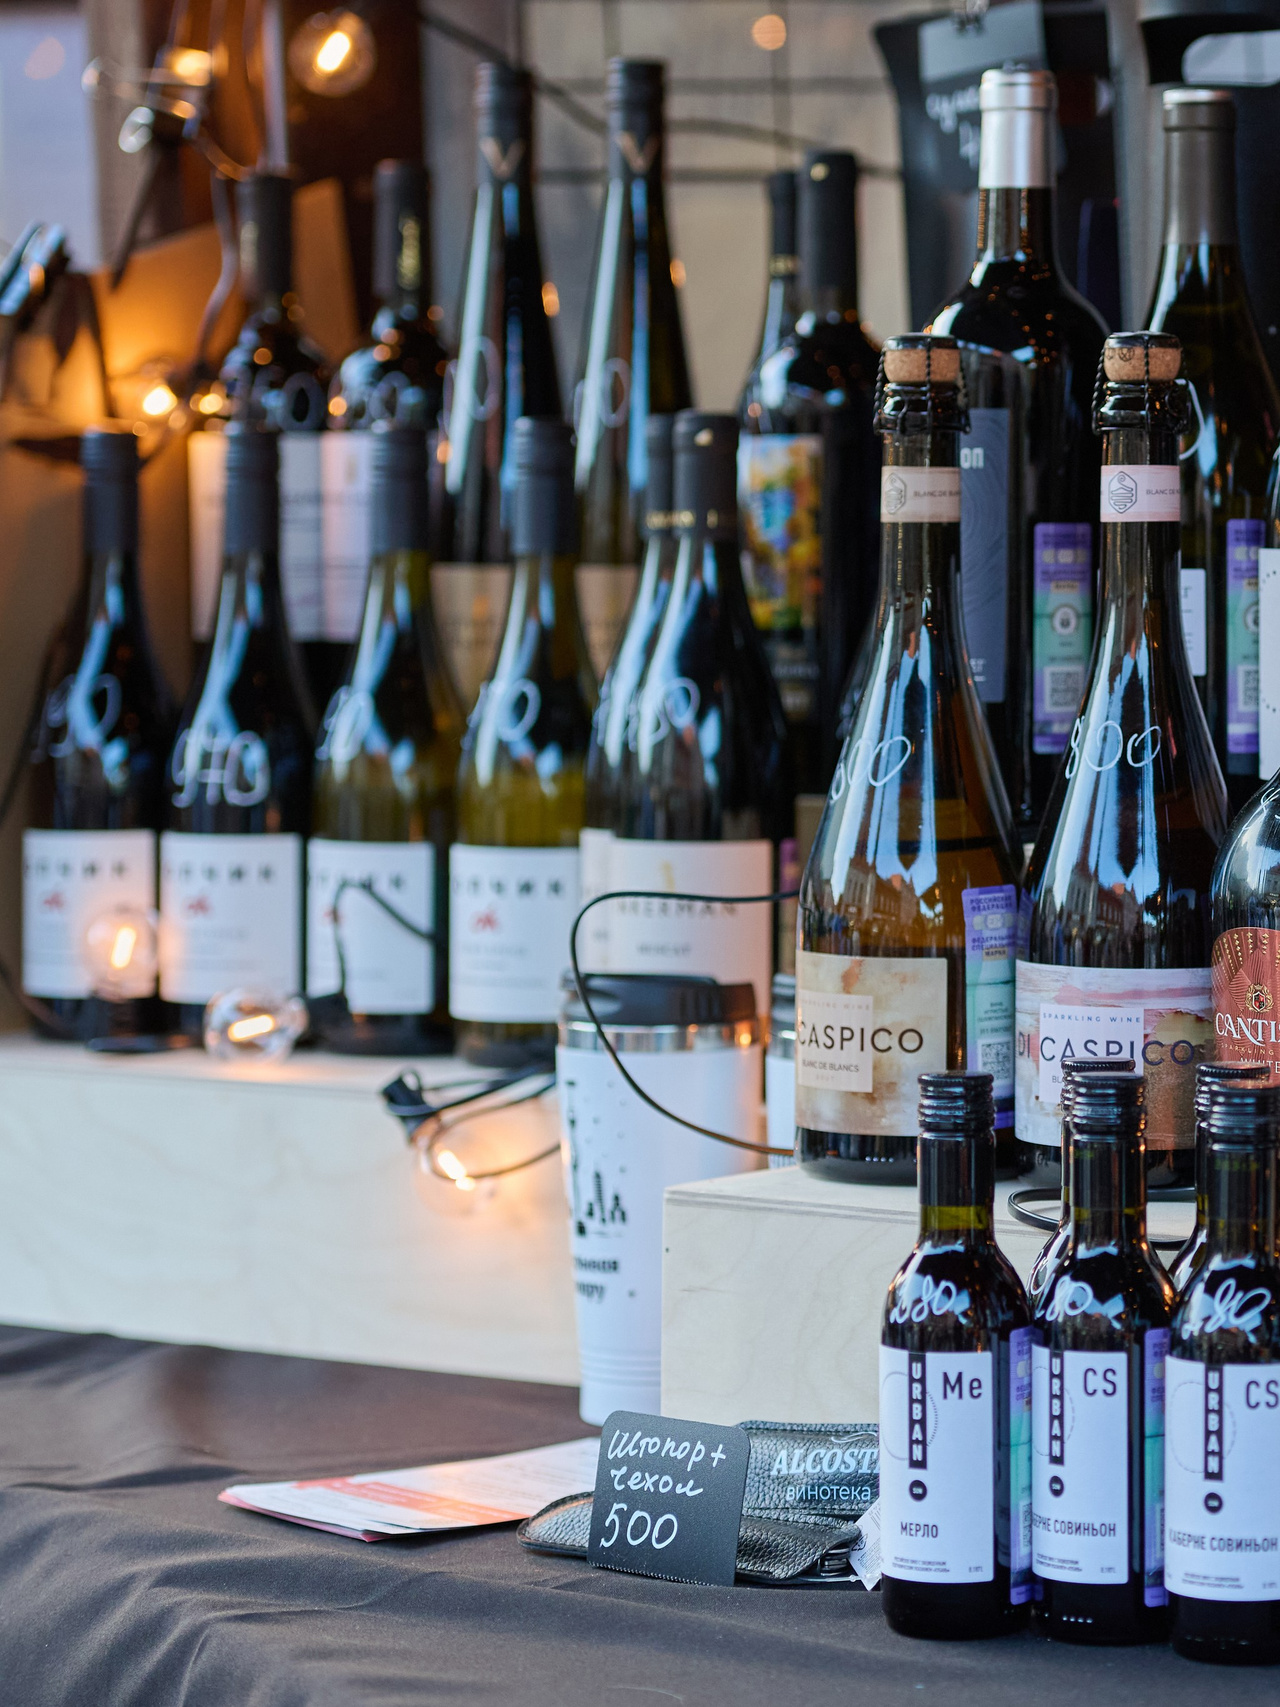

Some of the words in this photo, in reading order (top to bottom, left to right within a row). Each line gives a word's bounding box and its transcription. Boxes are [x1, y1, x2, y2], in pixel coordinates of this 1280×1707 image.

[1043, 1013, 1102, 1023] SPARKLING
[1109, 1016, 1142, 1024] WINE
[798, 1020, 924, 1054] CASPICO
[1040, 1036, 1195, 1067] CASPICO
[1221, 1042, 1275, 1056] SPARKLING
[941, 1371, 983, 1401] Me
[1082, 1367, 1118, 1397] CS
[1245, 1380, 1280, 1410] CS
[911, 1362, 924, 1462] URBAN
[1051, 1357, 1062, 1458] URBAN
[1207, 1371, 1220, 1475] URBAN
[786, 1484, 872, 1502] винотека
[600, 1502, 679, 1550] 500
[900, 1521, 939, 1539] МЕРЛО
[1053, 1518, 1117, 1538] СОВИНЬОН
[1209, 1535, 1279, 1553] СОВИНЬОН
